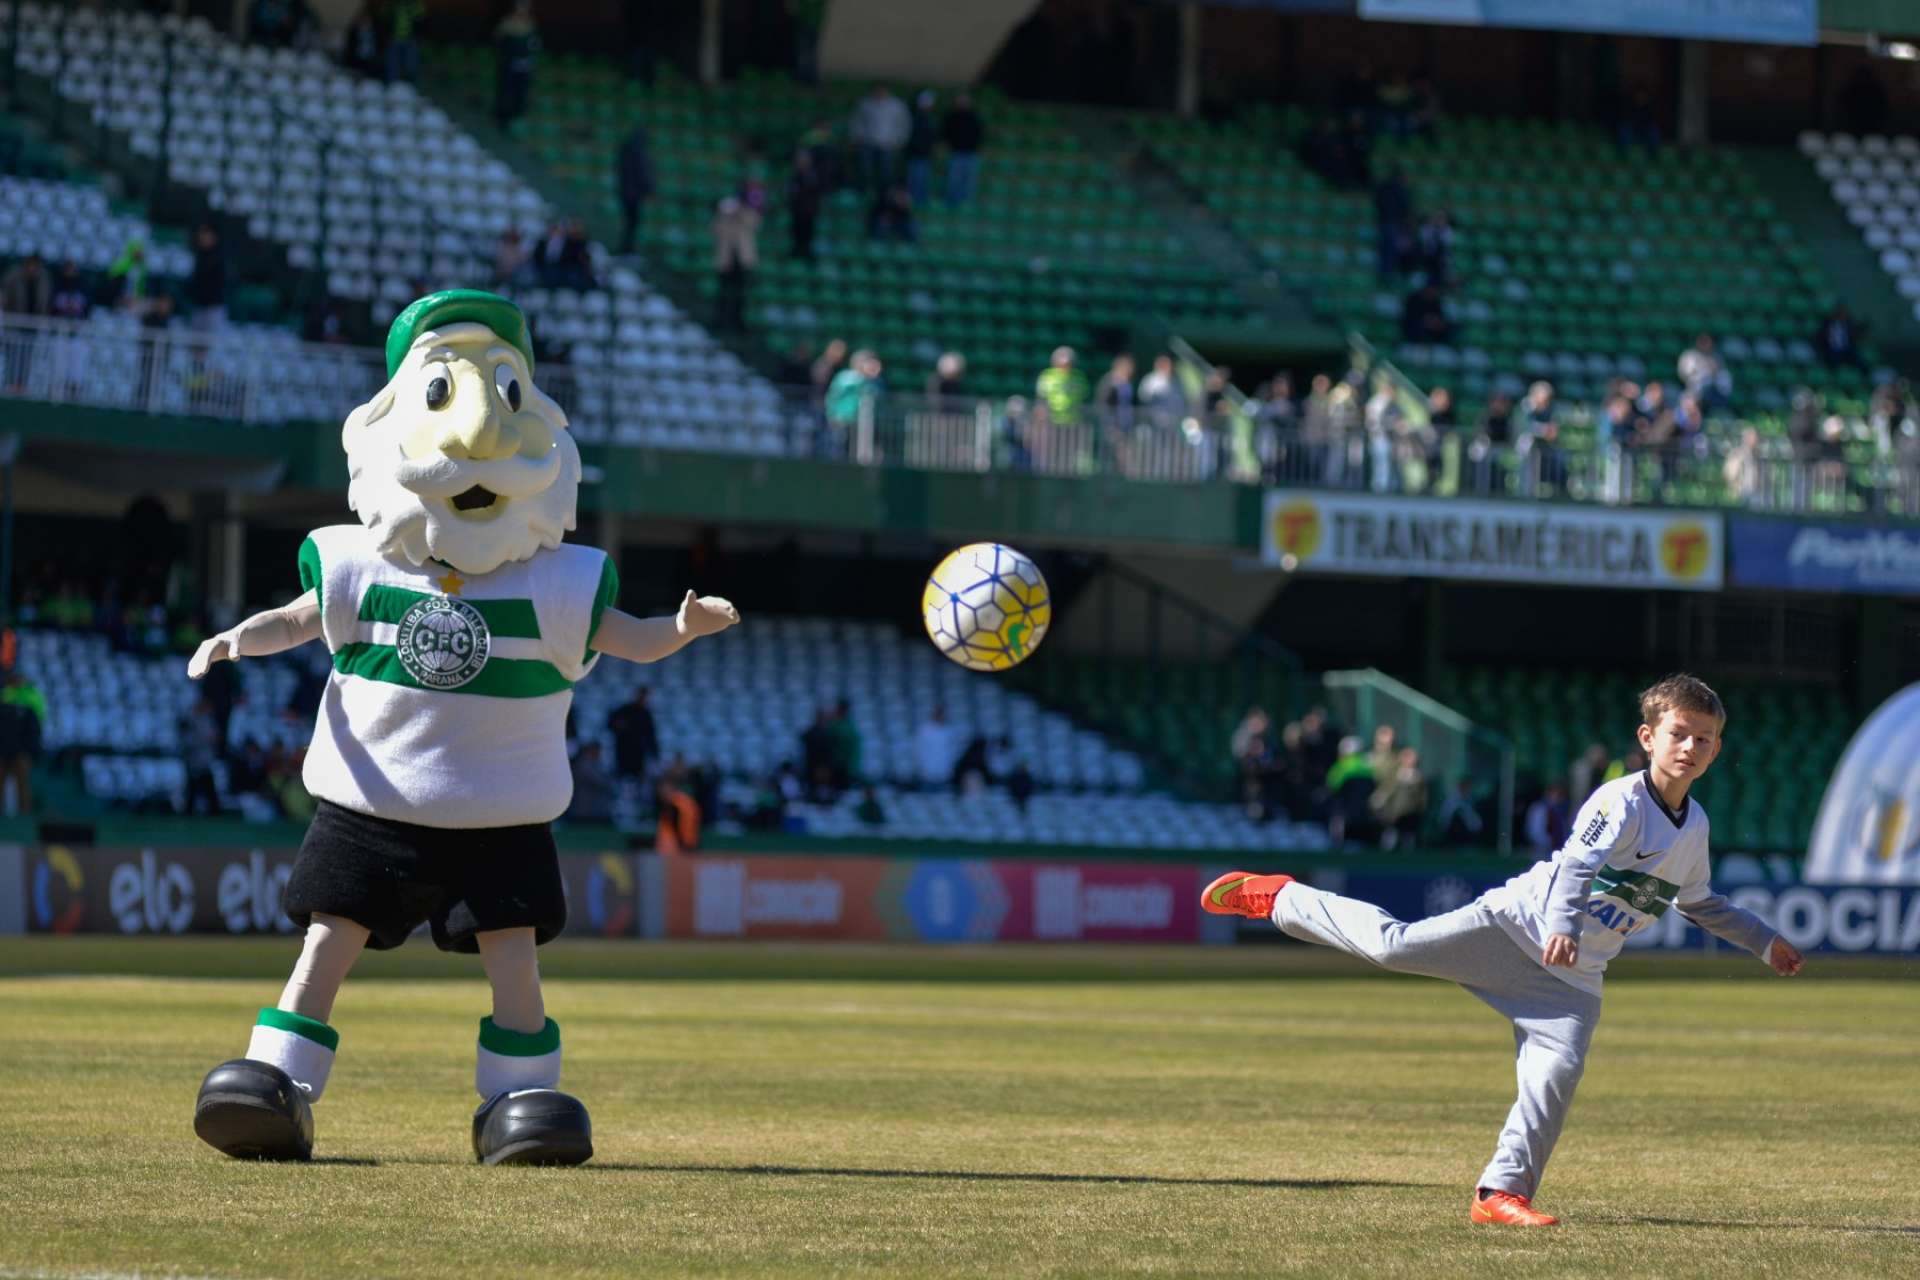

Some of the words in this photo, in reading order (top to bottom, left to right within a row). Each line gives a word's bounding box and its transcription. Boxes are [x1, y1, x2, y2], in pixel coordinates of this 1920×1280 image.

[1334, 513, 1650, 574] TRANSAMÉRICA
[400, 608, 425, 664] CORITIBA
[424, 599, 456, 612] FOOT
[415, 628, 470, 655] CFC
[1585, 817, 1609, 848] TORK
